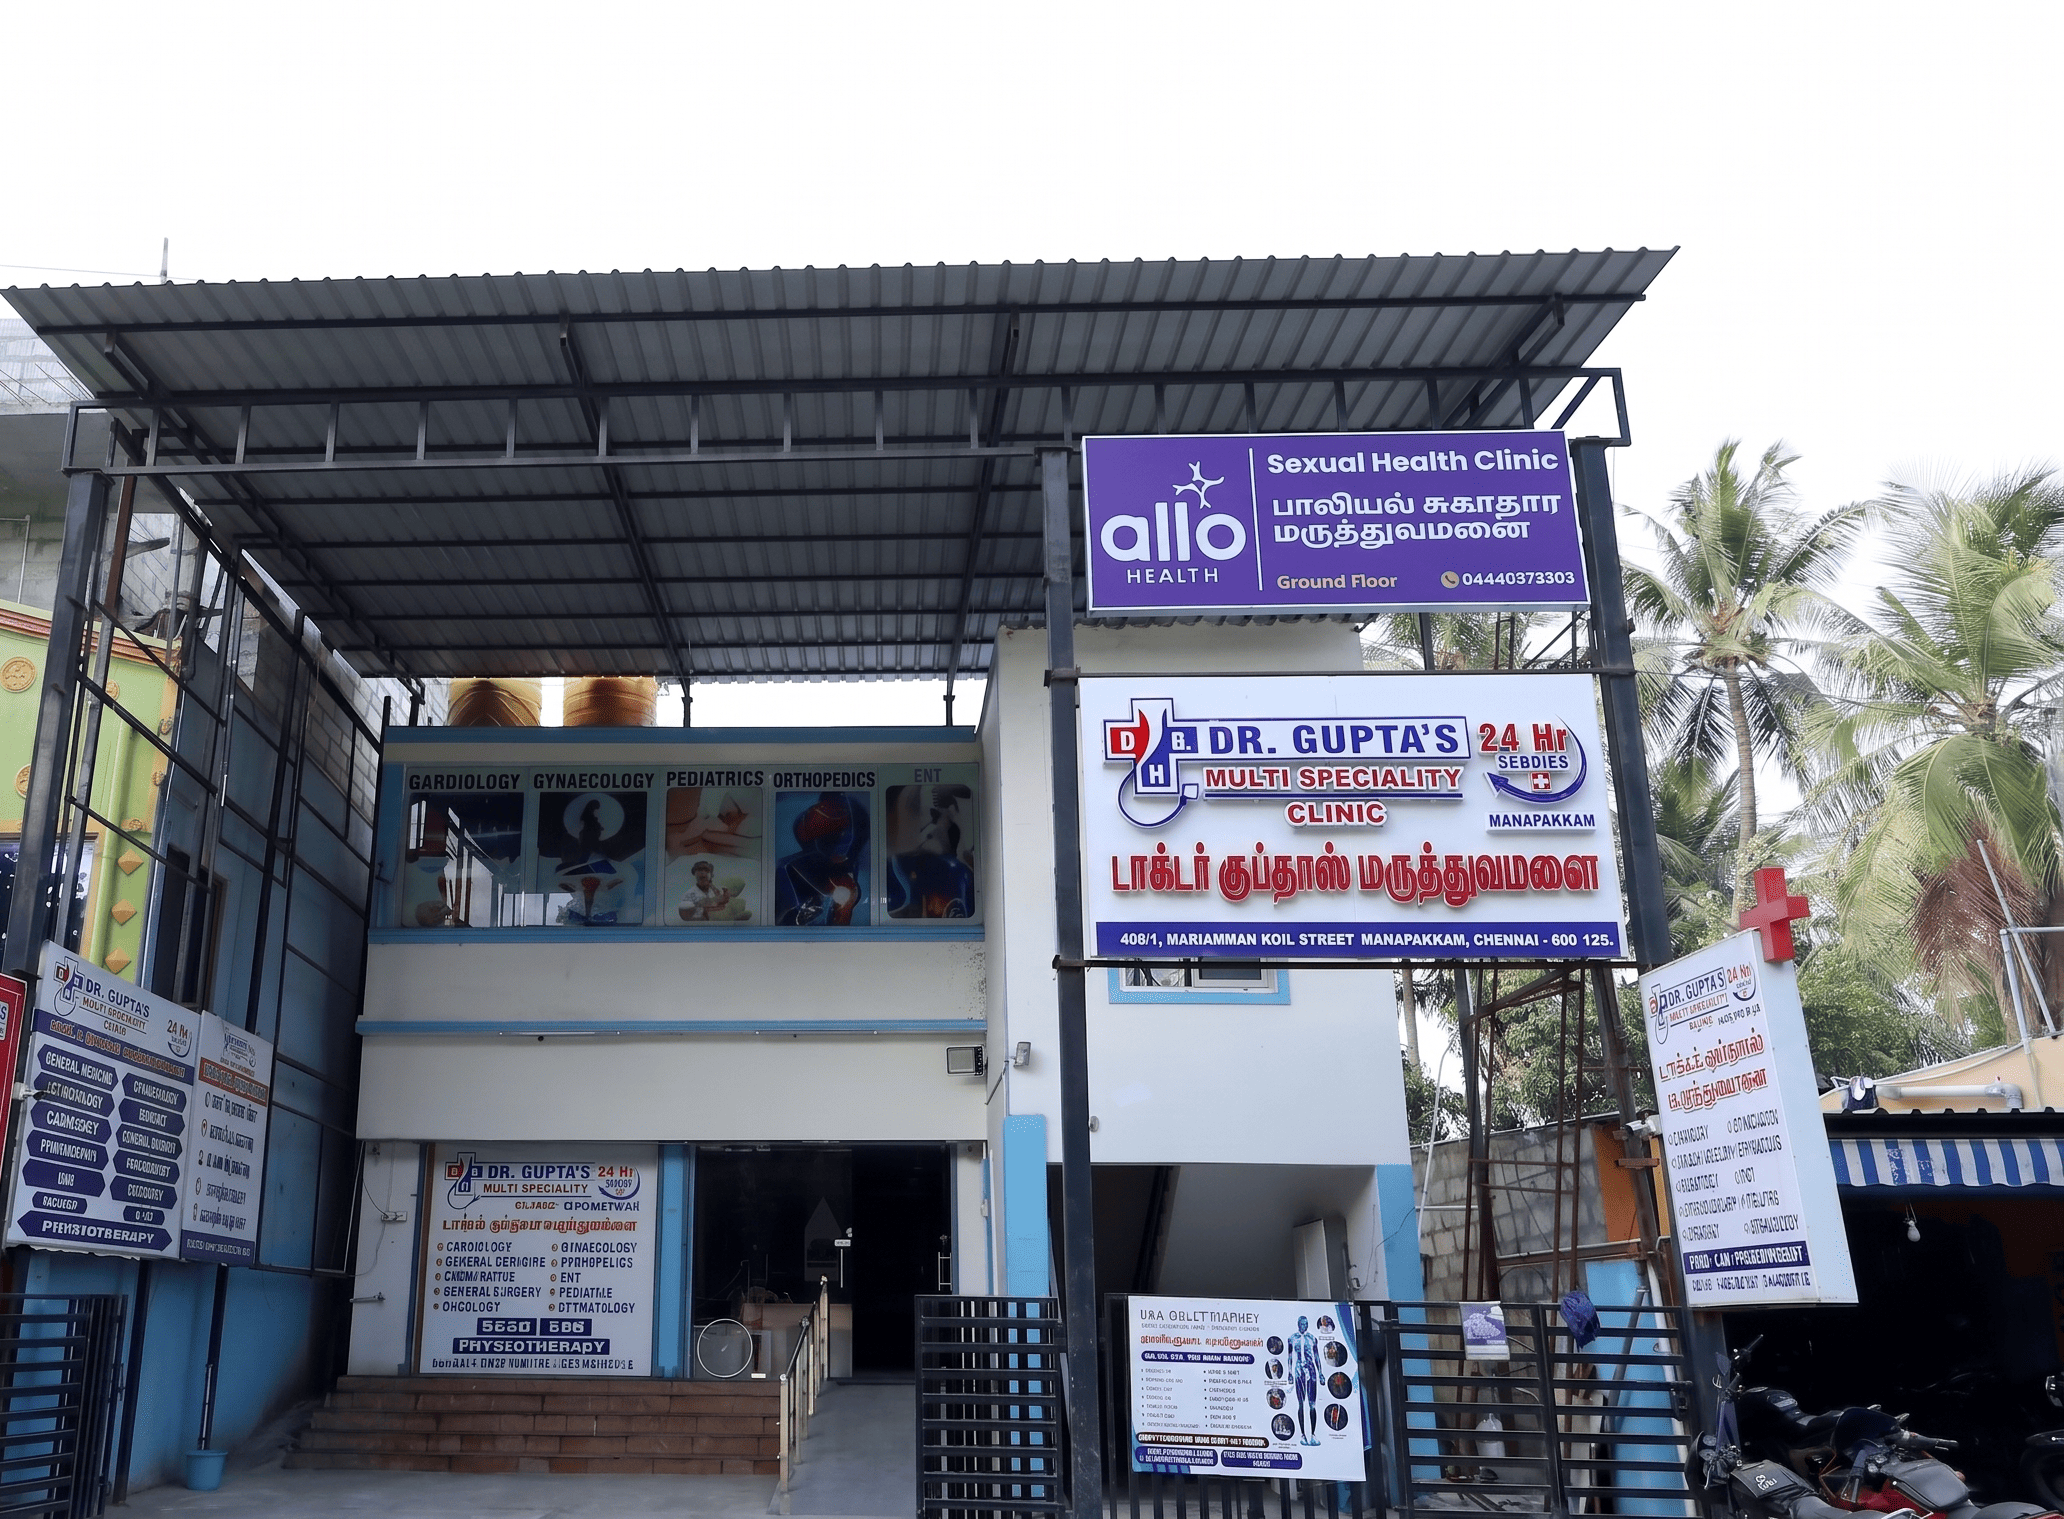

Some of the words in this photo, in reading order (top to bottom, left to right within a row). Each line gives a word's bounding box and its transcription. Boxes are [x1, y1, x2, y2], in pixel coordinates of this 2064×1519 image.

[1267, 451, 1365, 474] Sexual
[1372, 449, 1468, 473] Health
[1474, 447, 1559, 471] Clinic
[1272, 491, 1416, 517] பாலியல்
[1423, 493, 1562, 520] சுகாதார
[1100, 502, 1247, 562] allo
[1273, 518, 1531, 550] மருத்துவமனை
[1126, 567, 1219, 584] HEALTH
[1276, 574, 1347, 590] Ground
[1350, 573, 1398, 589] Floor
[1461, 570, 1576, 586] 04440373303
[1120, 730, 1136, 751] D
[1208, 725, 1277, 754] DR.
[1478, 722, 1520, 753] 24
[1531, 722, 1567, 753] Hr
[533, 772, 655, 789] GYNAECOLOGY
[666, 770, 764, 787] PEDIATRICS
[773, 771, 876, 788] ORTHOPEDICS
[914, 768, 942, 783] ENT
[1149, 764, 1165, 784] H
[1204, 768, 1290, 788] MULTI
[1299, 768, 1461, 788] SPECIALITY
[1286, 803, 1385, 824] CLINIC
[1489, 813, 1596, 828] MANAPAKKAM
[1120, 932, 1163, 948] 408/1,
[1166, 933, 1257, 946] MARIAMMAN
[1261, 933, 1295, 946] KOIL
[1299, 933, 1355, 946] STREET
[1361, 933, 1470, 948] MANAPAKKAM,
[1473, 933, 1539, 946] CHENNAI
[1551, 933, 1577, 946] 600
[1582, 933, 1614, 946] 125.
[487, 1165, 515, 1179] DR.
[521, 1165, 591, 1179] GUPTA'S
[598, 1166, 615, 1178] 24
[483, 1183, 518, 1193] MULTI
[521, 1183, 589, 1194] SPECIALITY
[560, 1272, 582, 1283] ENT
